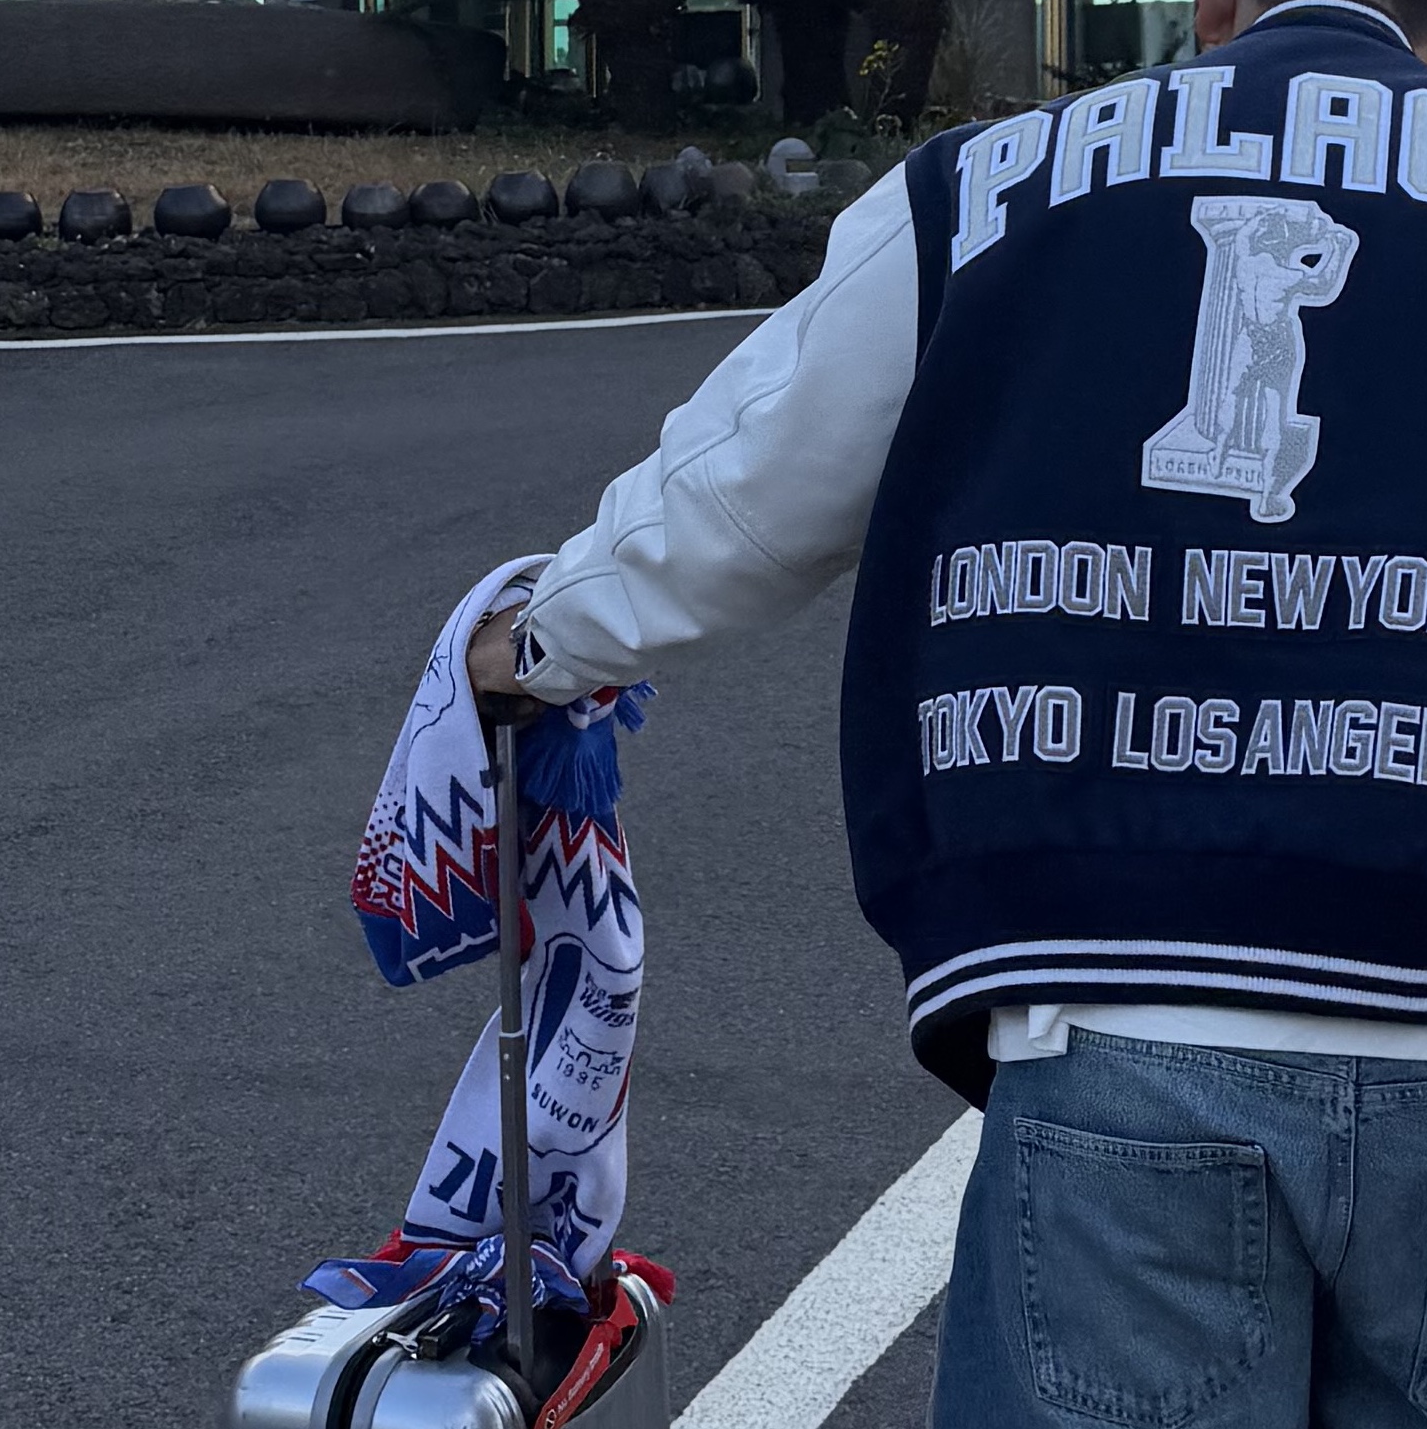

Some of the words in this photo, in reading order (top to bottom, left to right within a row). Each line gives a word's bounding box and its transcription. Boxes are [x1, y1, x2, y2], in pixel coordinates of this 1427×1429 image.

[931, 540, 1151, 627] LONDON
[918, 685, 1081, 776] TOKYO
[531, 1083, 600, 1133] SUWON
